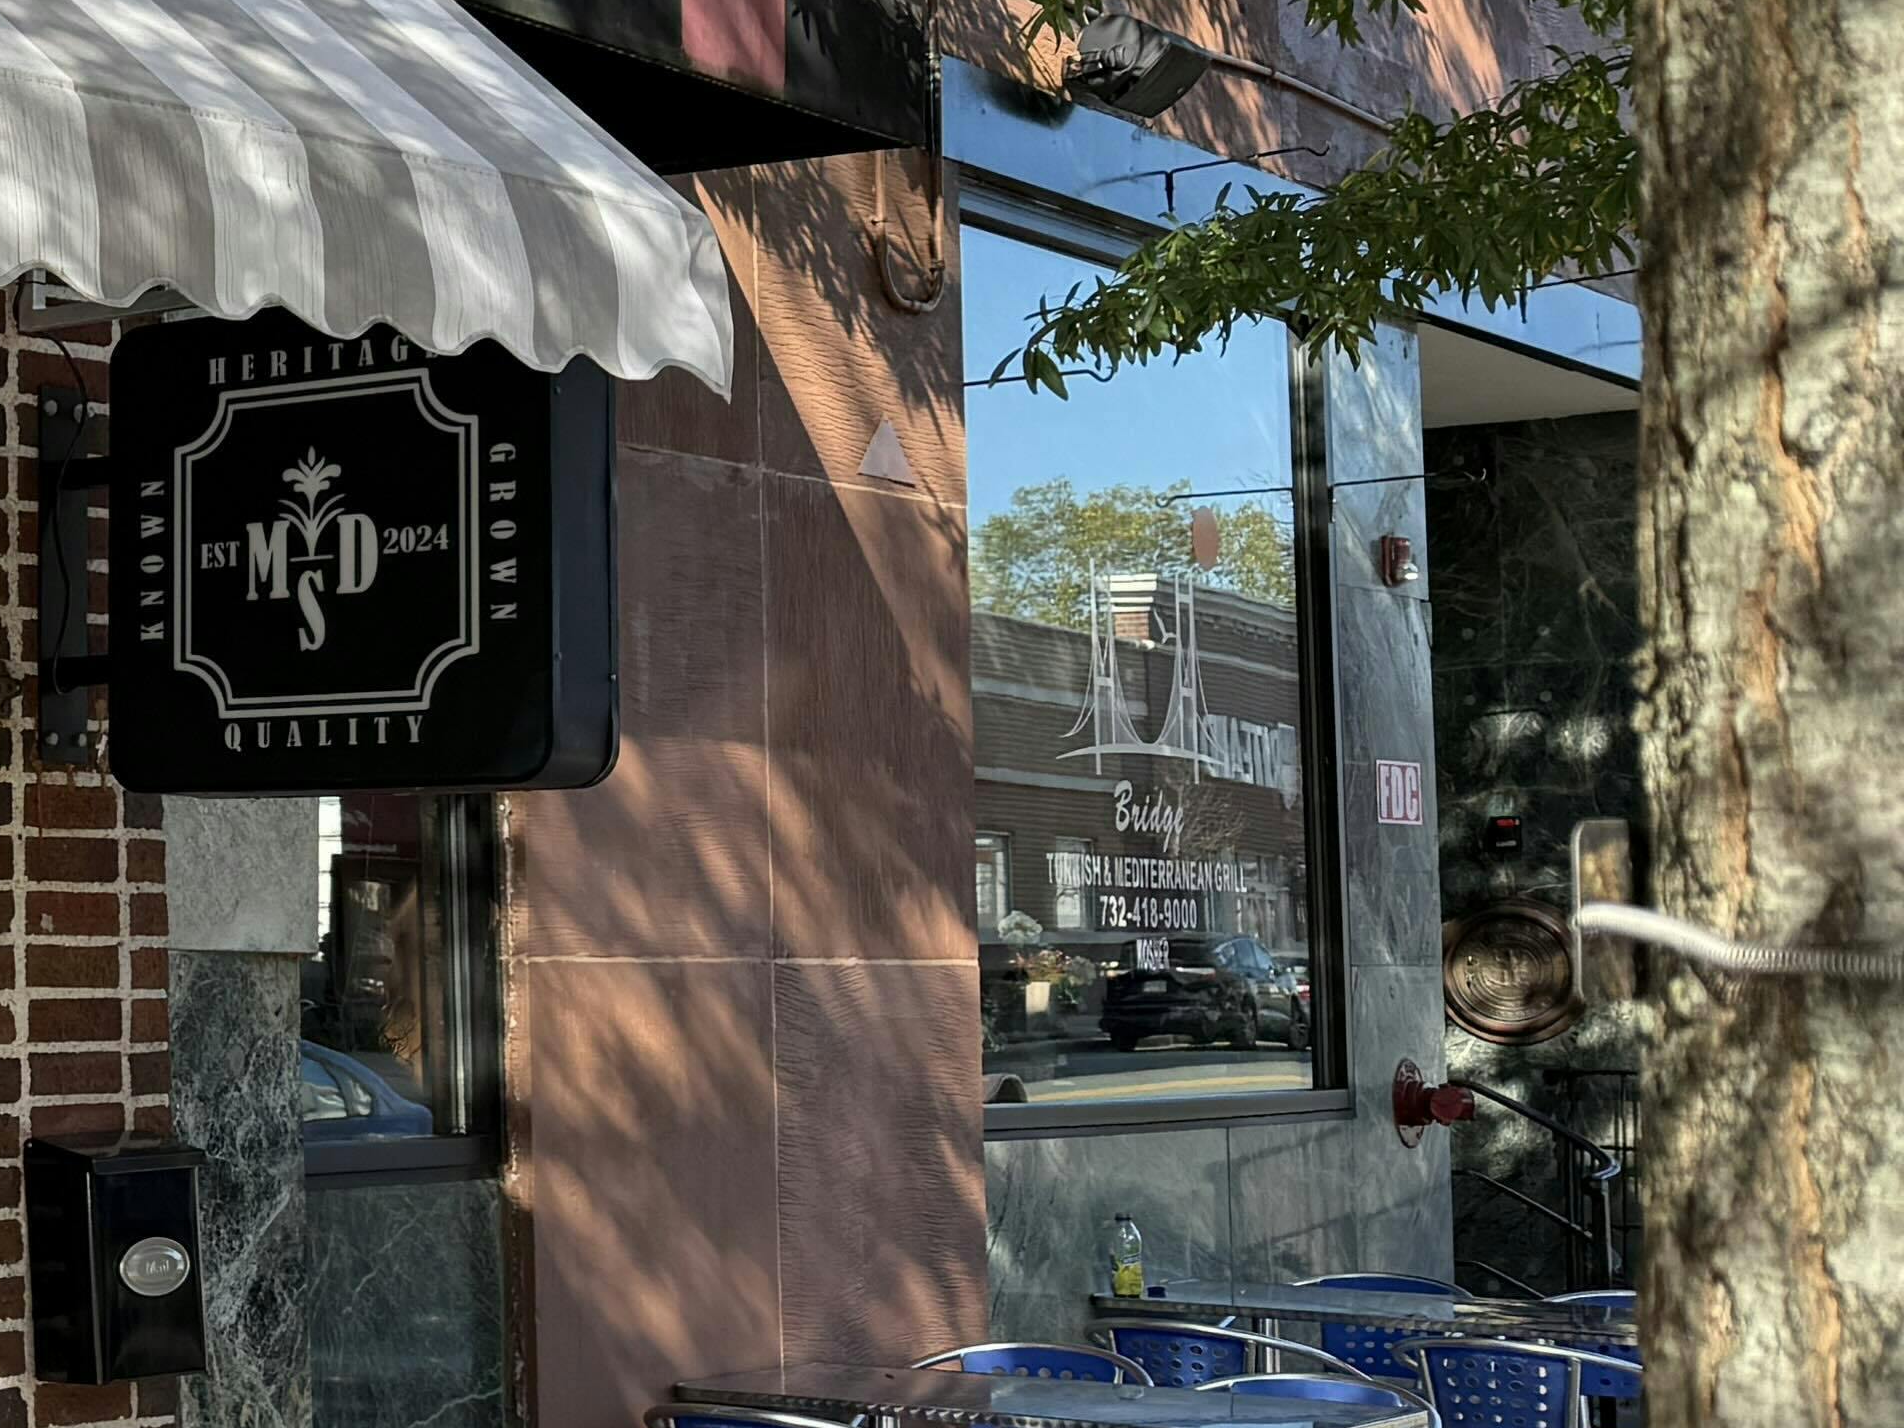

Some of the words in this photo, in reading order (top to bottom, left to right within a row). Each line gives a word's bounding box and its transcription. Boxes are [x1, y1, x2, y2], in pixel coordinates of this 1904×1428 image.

[209, 334, 439, 385] HERITAG
[200, 541, 241, 570] EST
[383, 524, 450, 555] 2024
[489, 441, 518, 620] GROWN
[140, 480, 165, 642] KNOWN
[224, 715, 426, 751] QUALITY
[1113, 779, 1184, 853] Bridge
[1379, 764, 1419, 820] FDC
[1046, 852, 1102, 887] TURKISH
[1103, 855, 1112, 886] &
[1114, 856, 1212, 892] MEDITERRANEAN
[1214, 861, 1247, 892] GRILL
[1100, 895, 1198, 929] 732-418-9000
